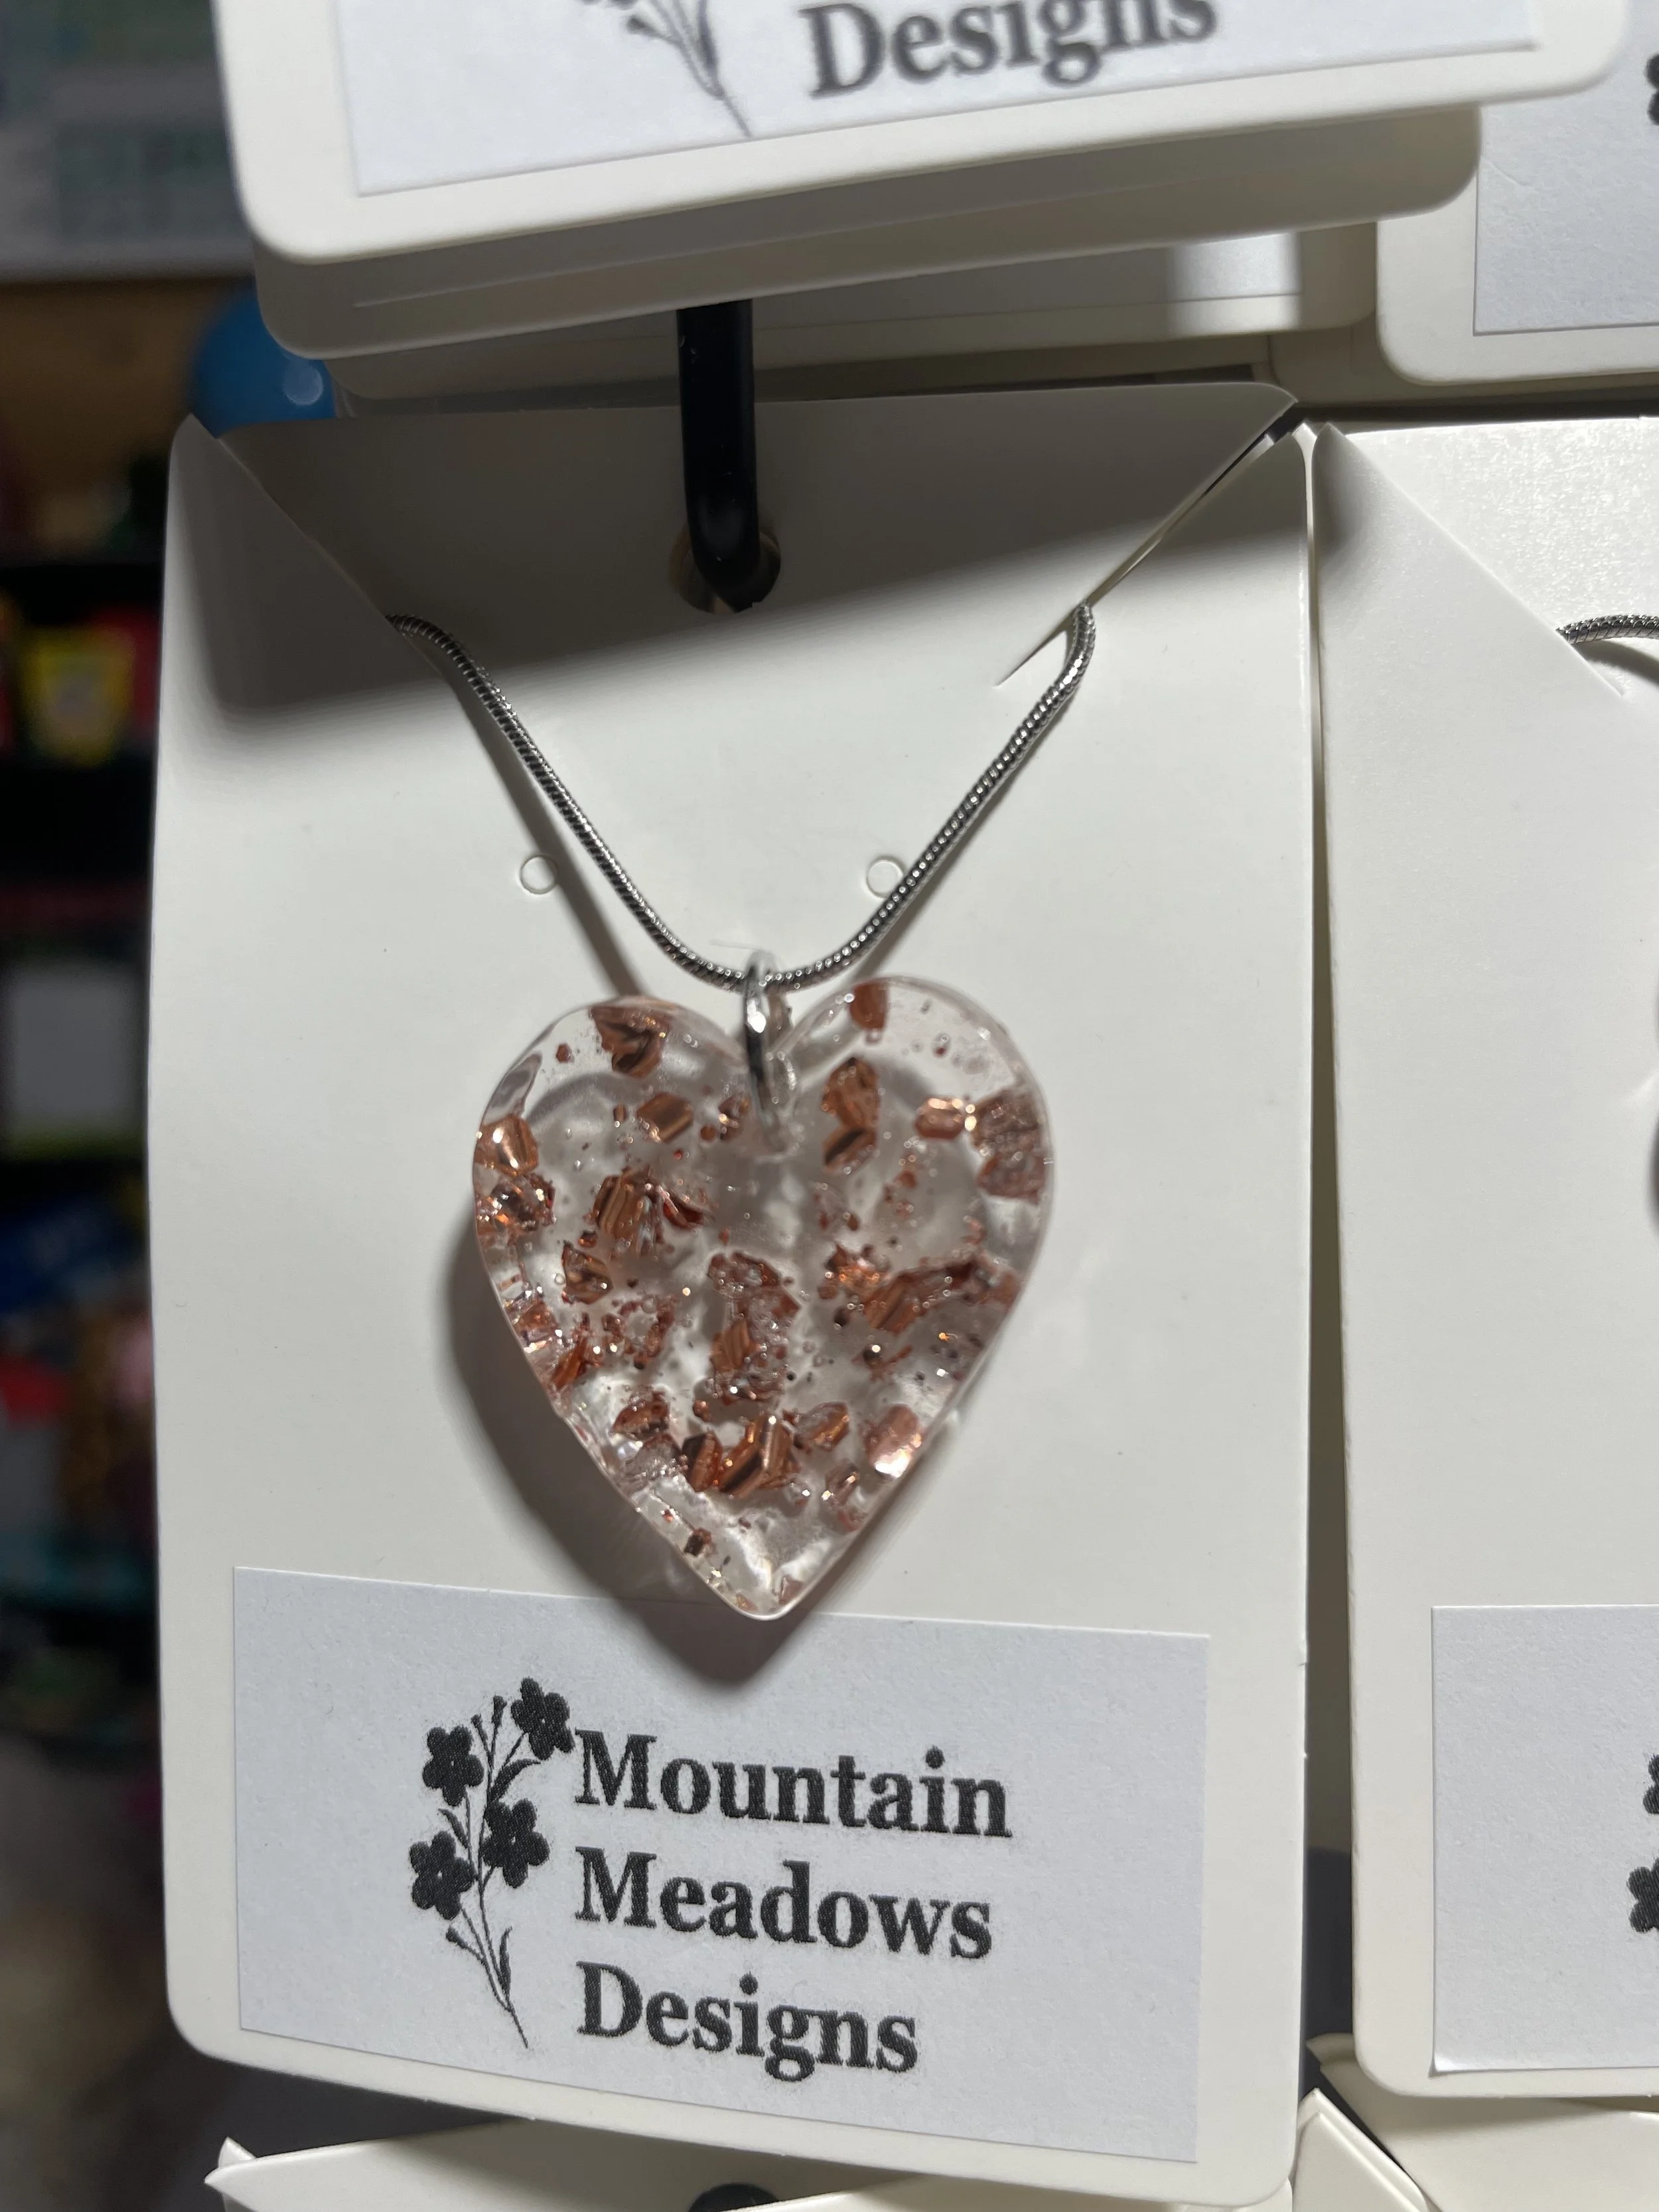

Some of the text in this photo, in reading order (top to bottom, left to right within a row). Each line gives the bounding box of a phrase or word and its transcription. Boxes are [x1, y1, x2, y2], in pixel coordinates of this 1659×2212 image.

[574, 1728, 1013, 1838] Mountain
[575, 1846, 992, 1960] Meadows
[575, 1960, 919, 2082] Designs
